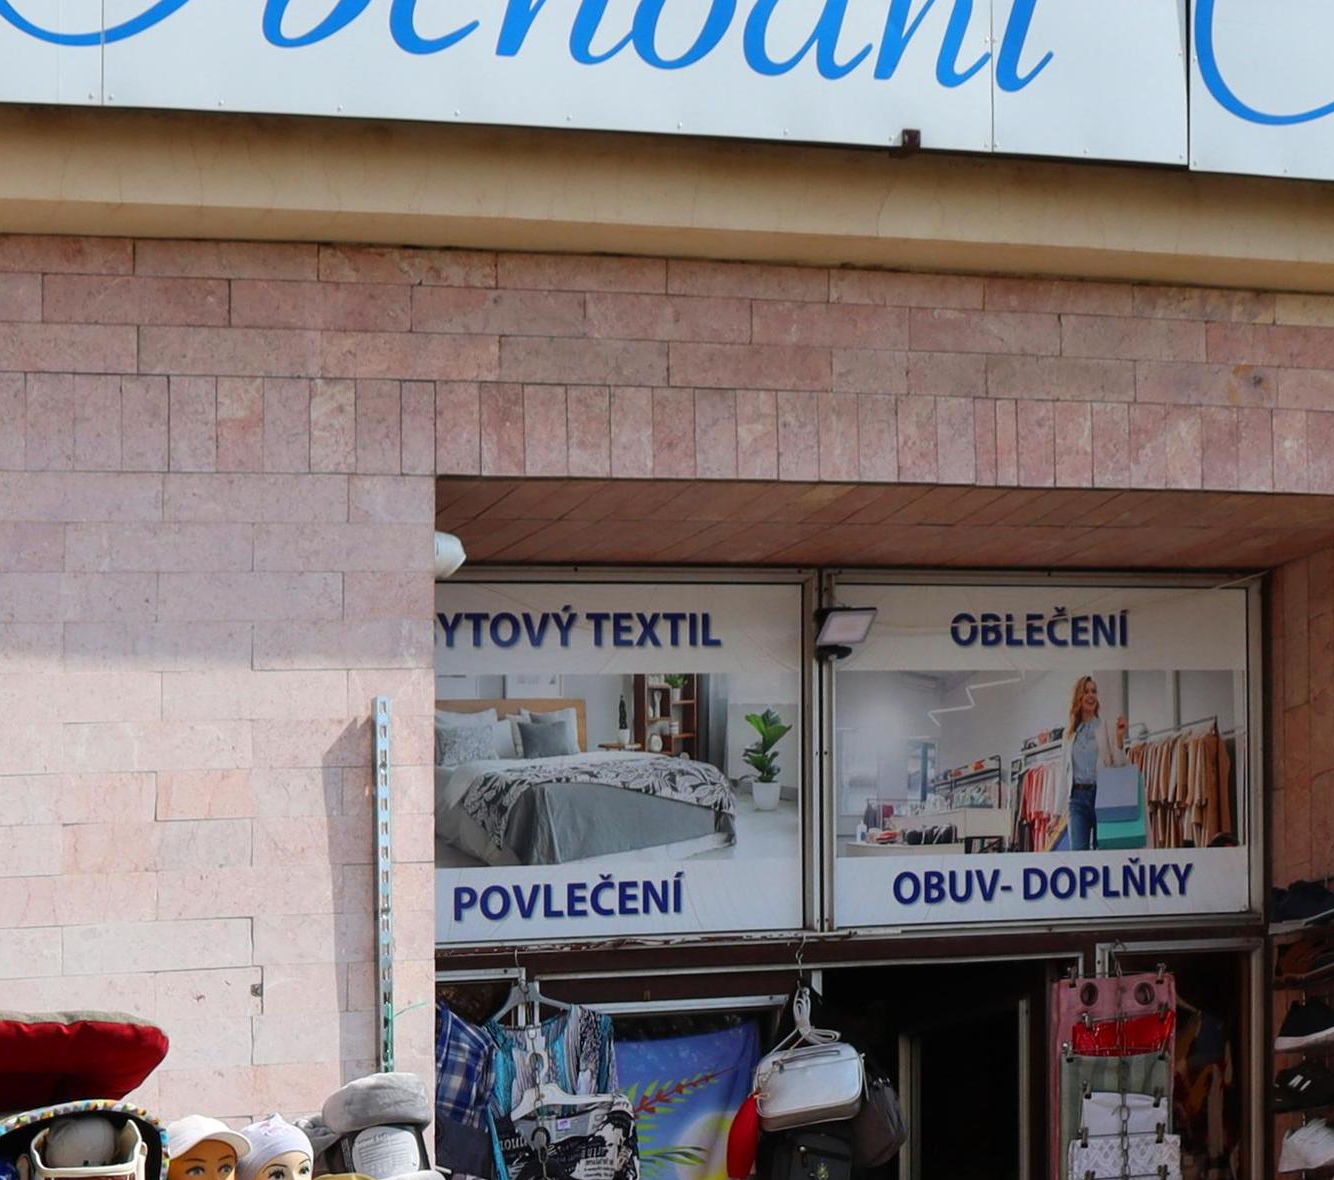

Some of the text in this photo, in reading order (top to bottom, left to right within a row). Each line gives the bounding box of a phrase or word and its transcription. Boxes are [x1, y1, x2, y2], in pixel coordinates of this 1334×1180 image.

[435, 605, 722, 649] YTOVÝ TEXTIL
[950, 606, 1130, 648] OBLEČENÍ
[453, 871, 687, 923] POVLEČENÍ
[1021, 856, 1194, 902] DOPLŇKY
